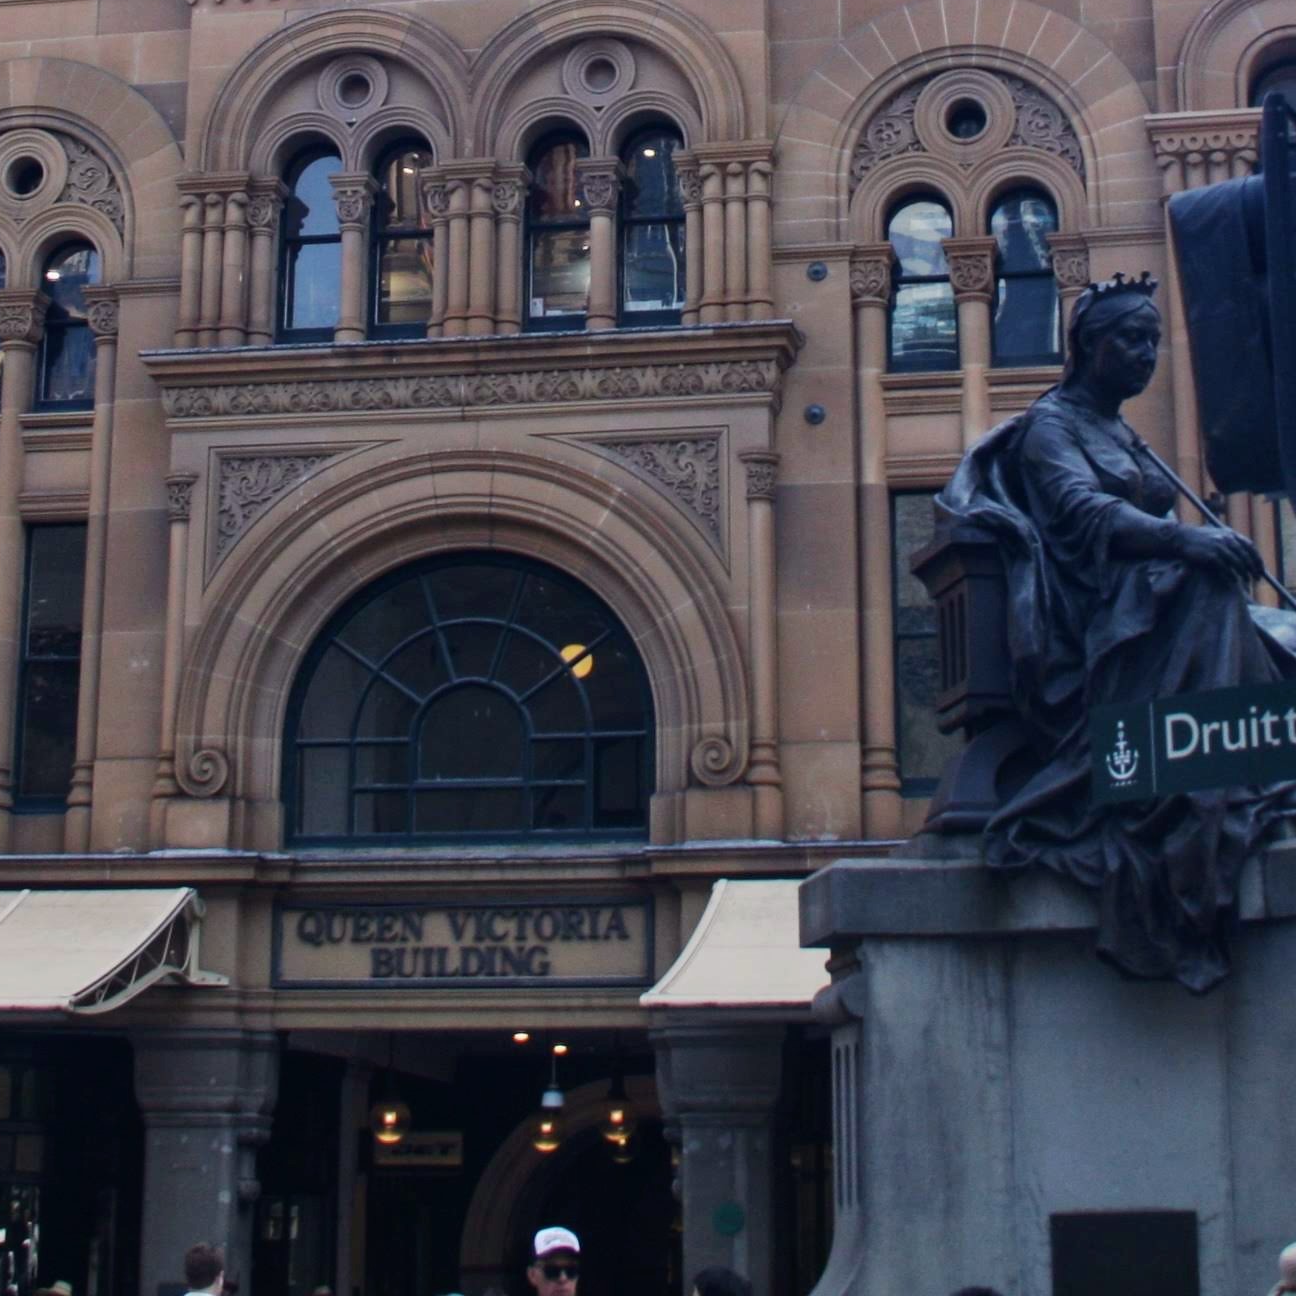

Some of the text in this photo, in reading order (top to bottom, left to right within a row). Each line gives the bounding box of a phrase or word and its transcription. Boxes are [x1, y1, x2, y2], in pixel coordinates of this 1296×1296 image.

[297, 907, 630, 947] QUEEN VICTORIA
[370, 945, 552, 979] BUILDING
